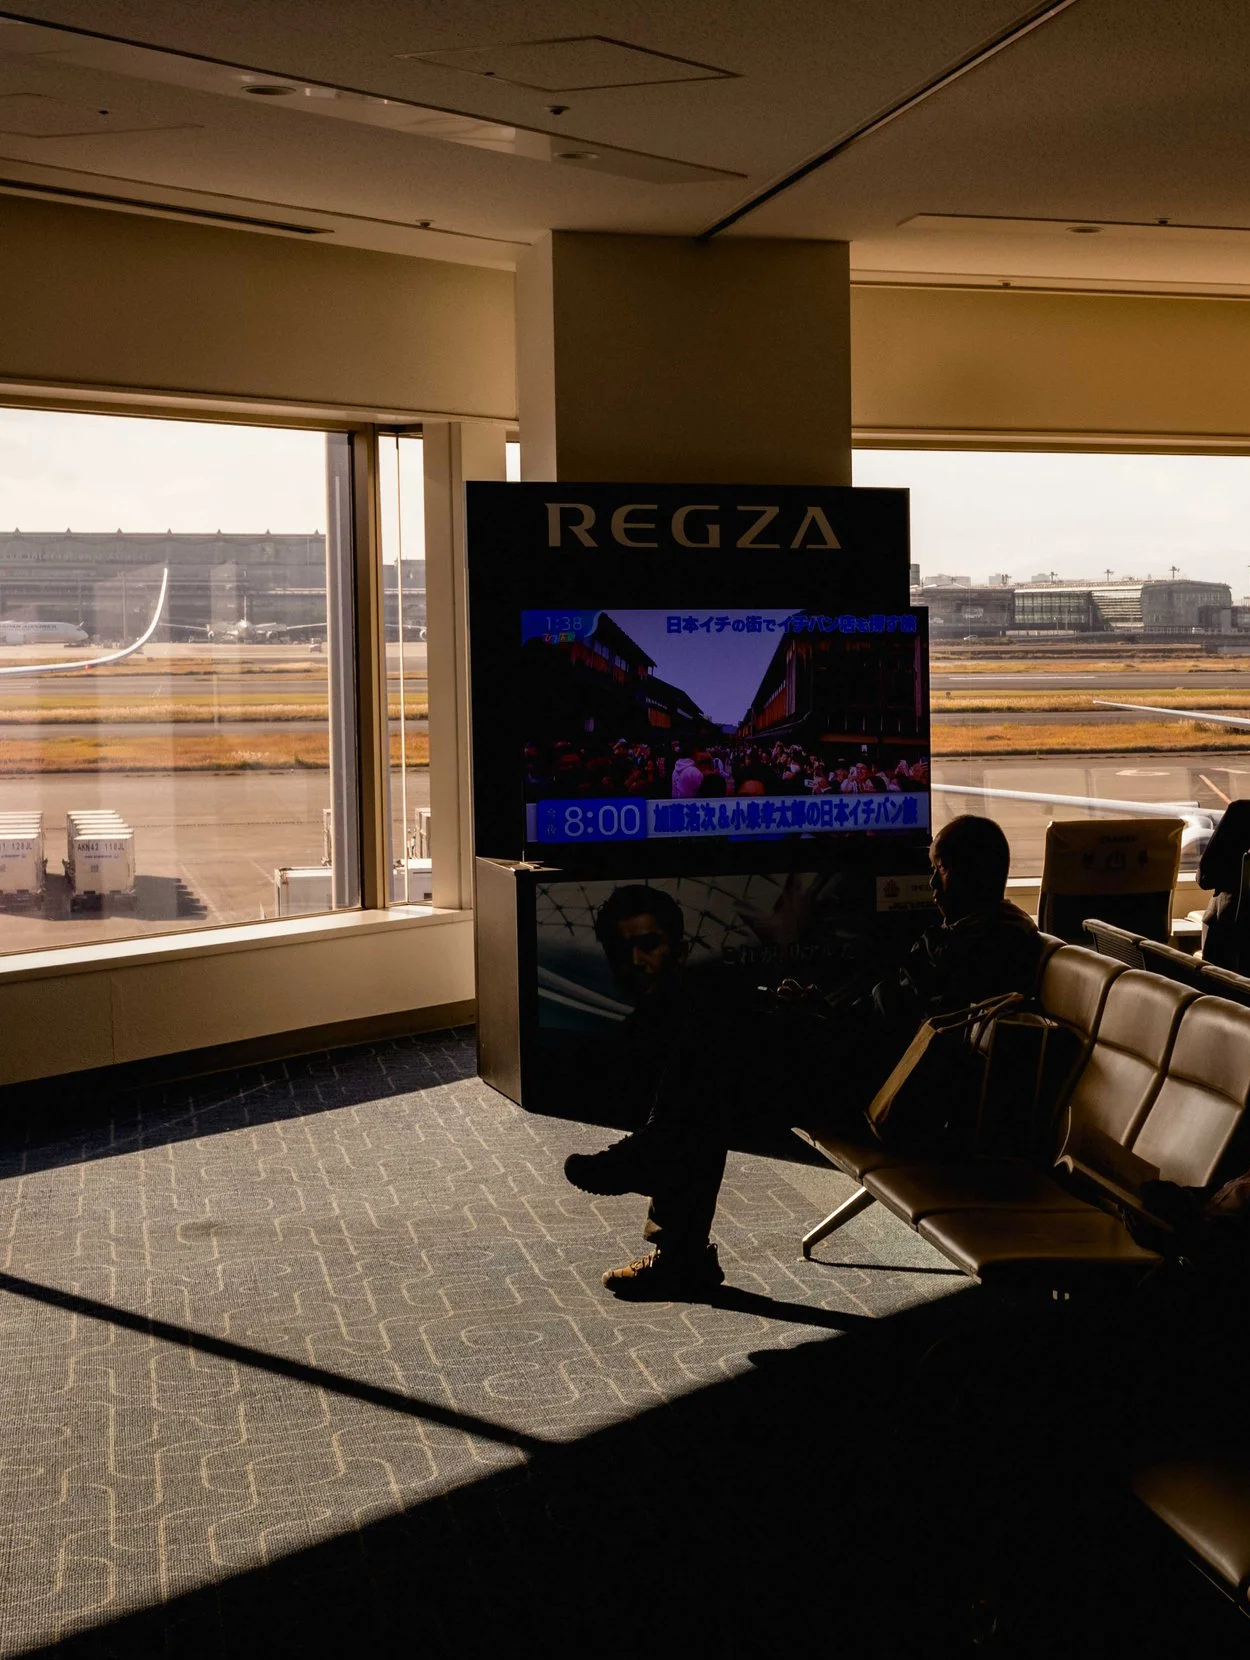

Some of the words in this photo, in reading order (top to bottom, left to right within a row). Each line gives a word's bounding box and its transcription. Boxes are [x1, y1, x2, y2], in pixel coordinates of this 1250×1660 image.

[544, 503, 842, 550] REGZA
[545, 616, 583, 631] 1:38
[564, 804, 641, 837] 8:00
